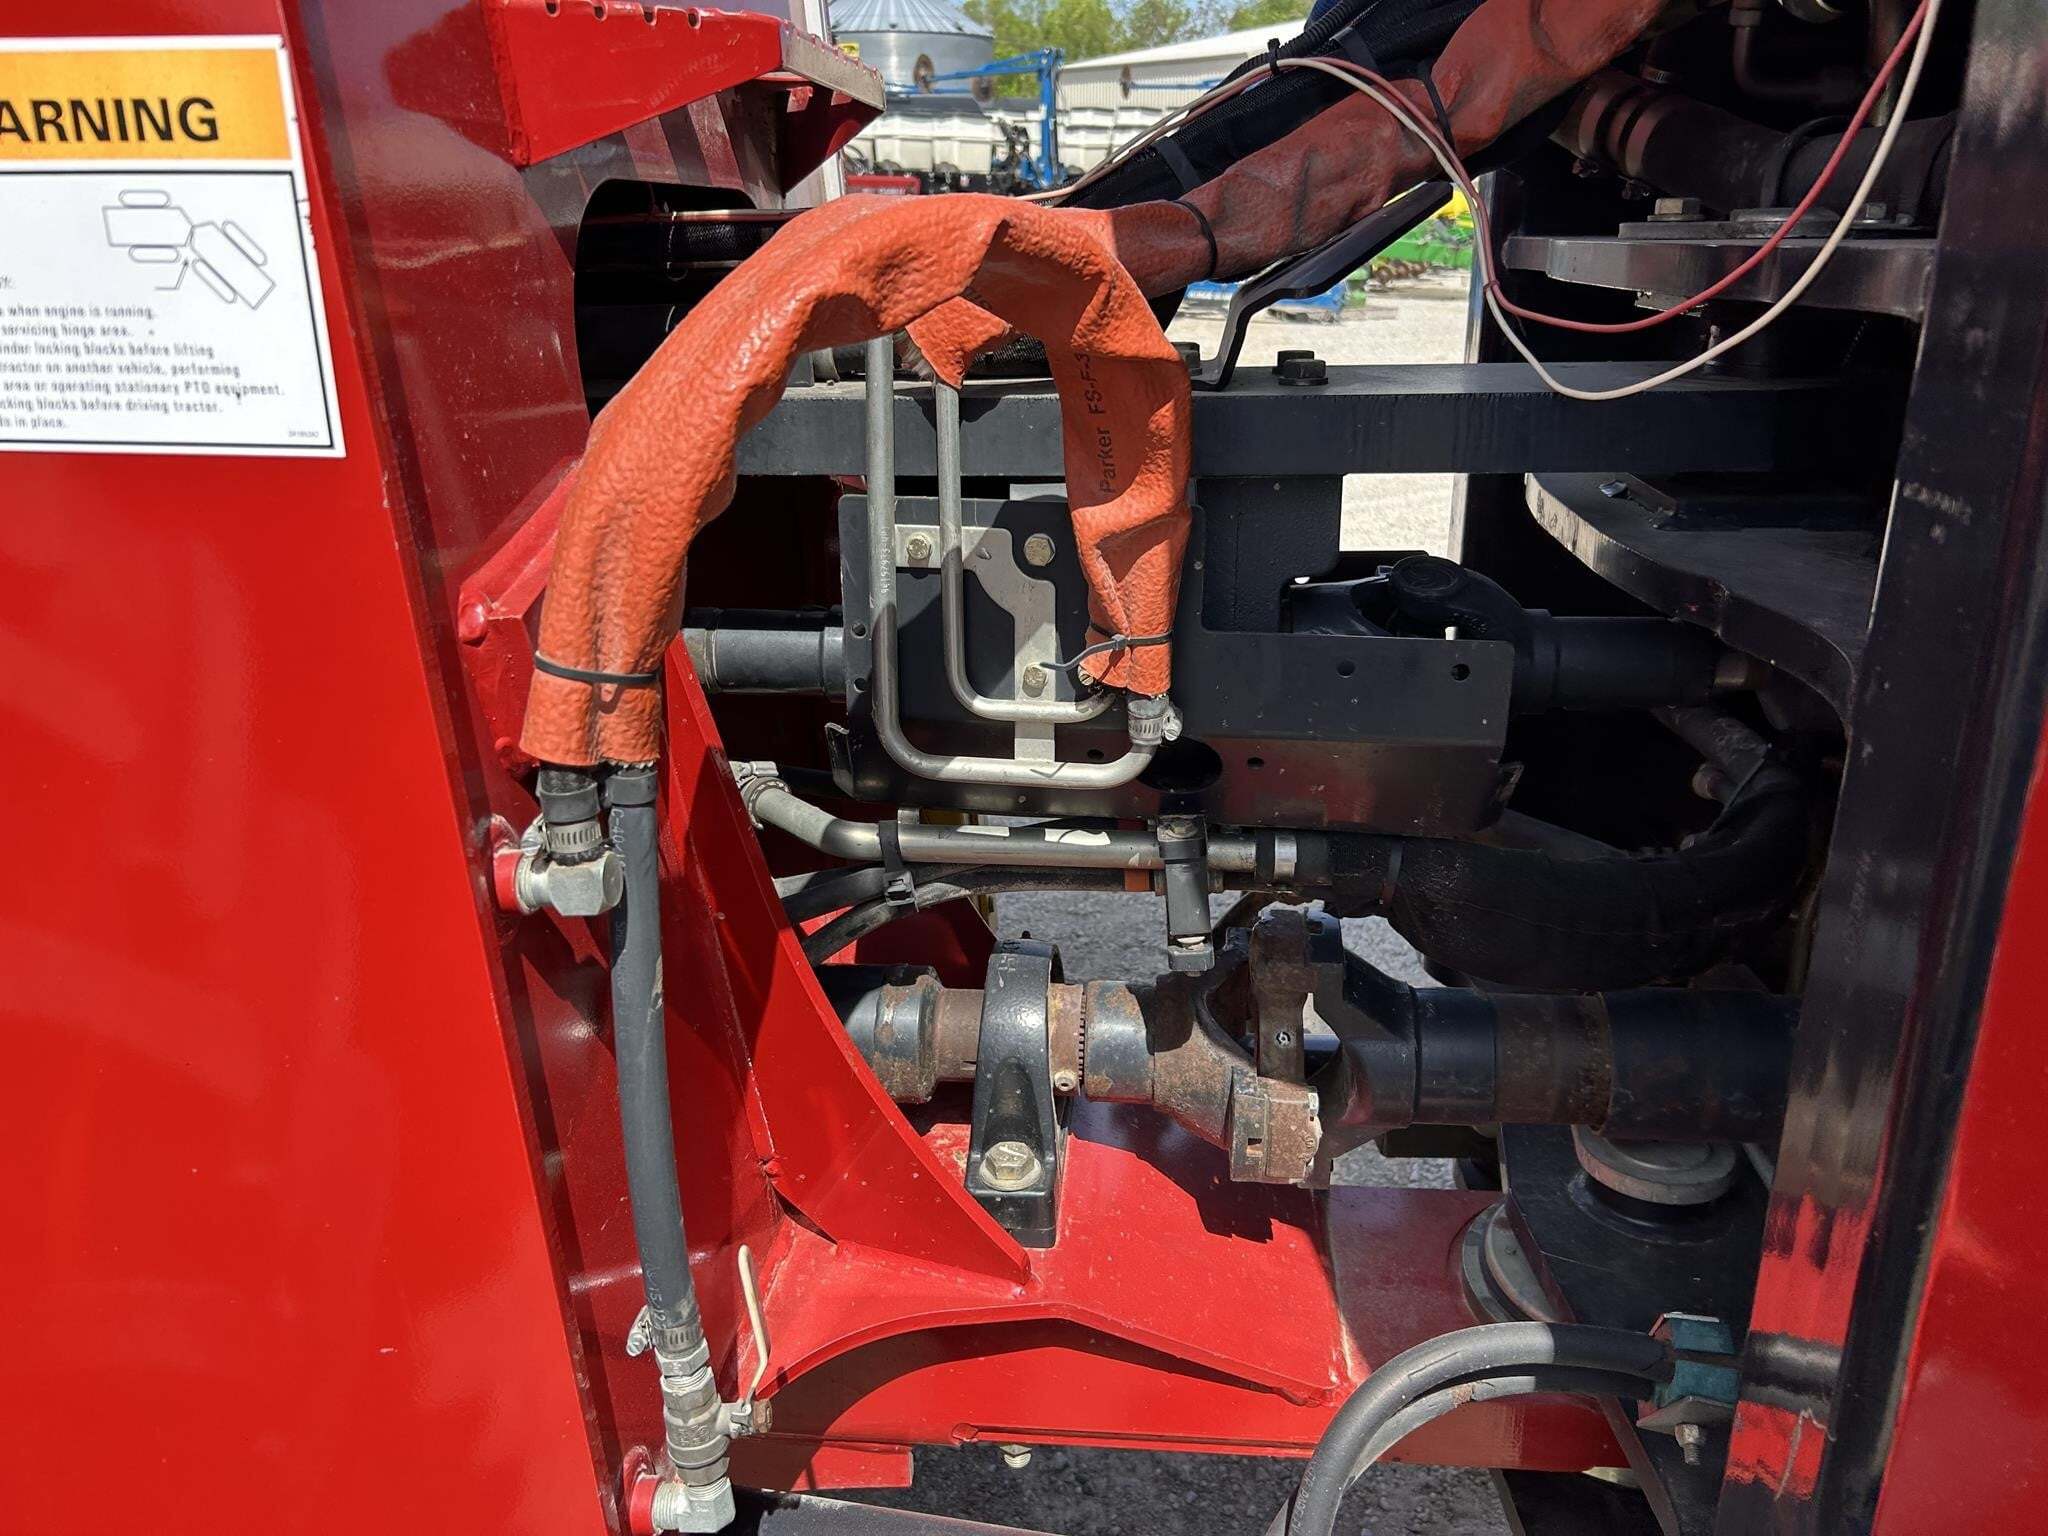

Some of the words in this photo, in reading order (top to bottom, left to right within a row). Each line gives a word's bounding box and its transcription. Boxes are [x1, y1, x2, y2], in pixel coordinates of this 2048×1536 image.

[0, 97, 219, 143] ARNING
[184, 381, 211, 394] PTO
[1097, 426, 1118, 494] Parker
